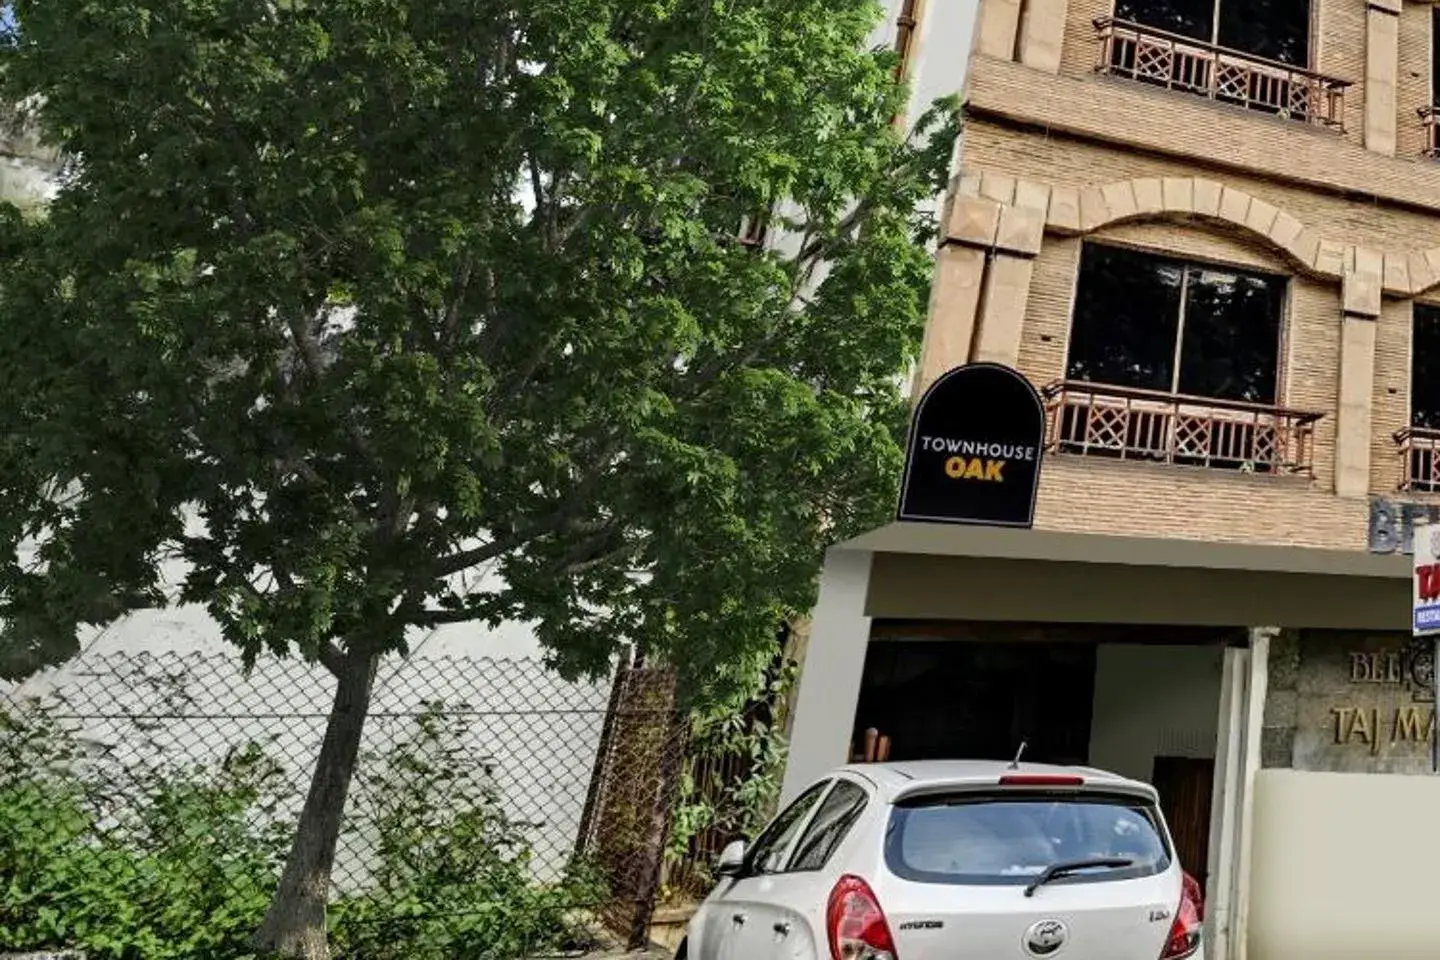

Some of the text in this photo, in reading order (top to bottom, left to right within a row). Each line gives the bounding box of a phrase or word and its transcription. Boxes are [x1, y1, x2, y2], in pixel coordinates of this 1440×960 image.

[921, 436, 1035, 461] TOWNHOUSE
[944, 456, 1006, 482] OAK
[1330, 704, 1381, 756] TAJ
